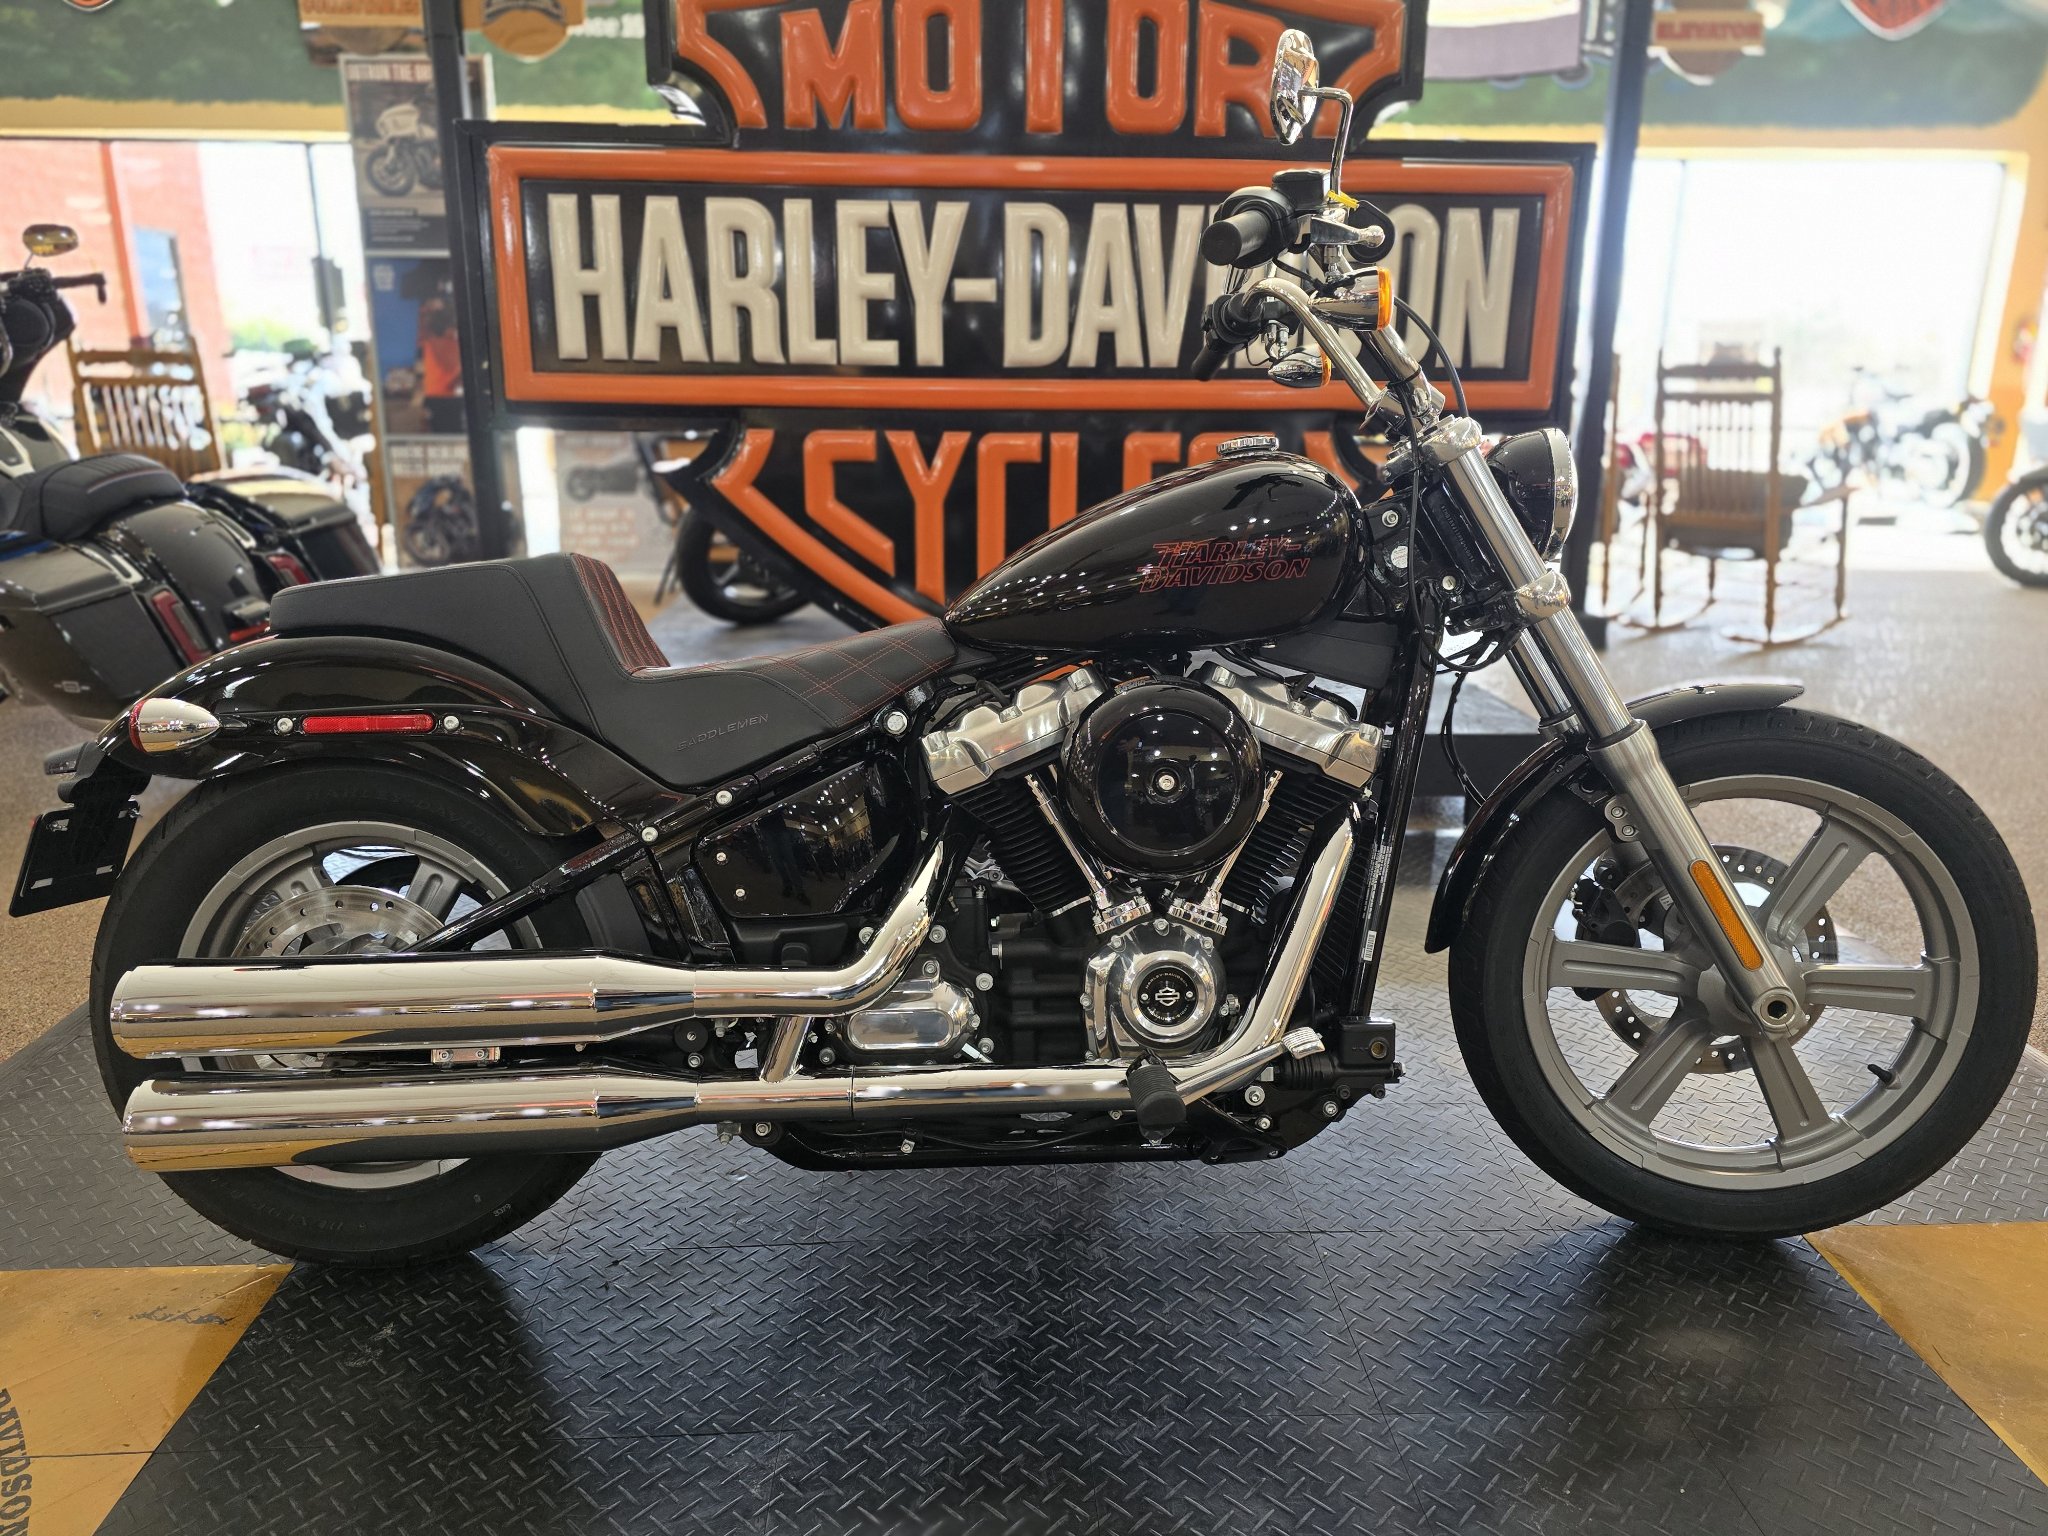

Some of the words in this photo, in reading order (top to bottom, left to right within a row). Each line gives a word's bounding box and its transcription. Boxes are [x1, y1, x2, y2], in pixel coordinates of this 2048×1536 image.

[782, 0, 1282, 138] MOTOR
[546, 193, 1519, 369] HARLEY-DAVON
[803, 429, 1278, 607] CYC
[1137, 557, 1311, 593] DAVIDSON
[677, 713, 769, 752] SADDLEMEN
